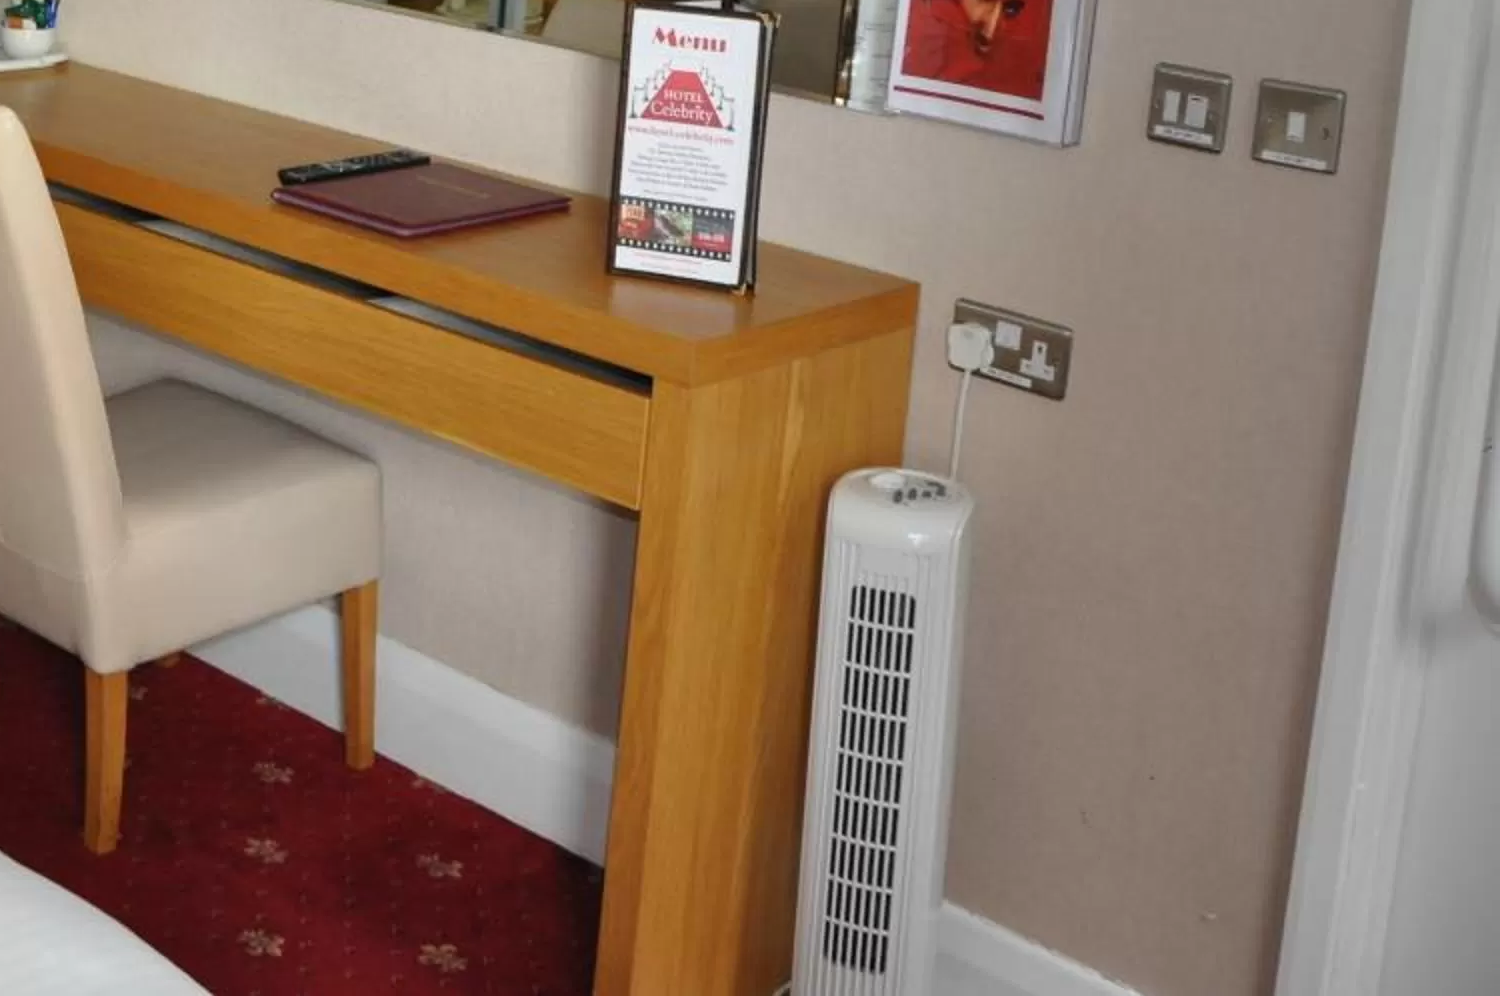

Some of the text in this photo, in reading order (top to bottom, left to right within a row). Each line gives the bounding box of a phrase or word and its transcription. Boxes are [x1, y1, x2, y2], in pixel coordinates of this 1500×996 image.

[652, 27, 727, 53] Menu
[663, 89, 705, 103] HOTEL
[651, 100, 713, 124] Celebrity
